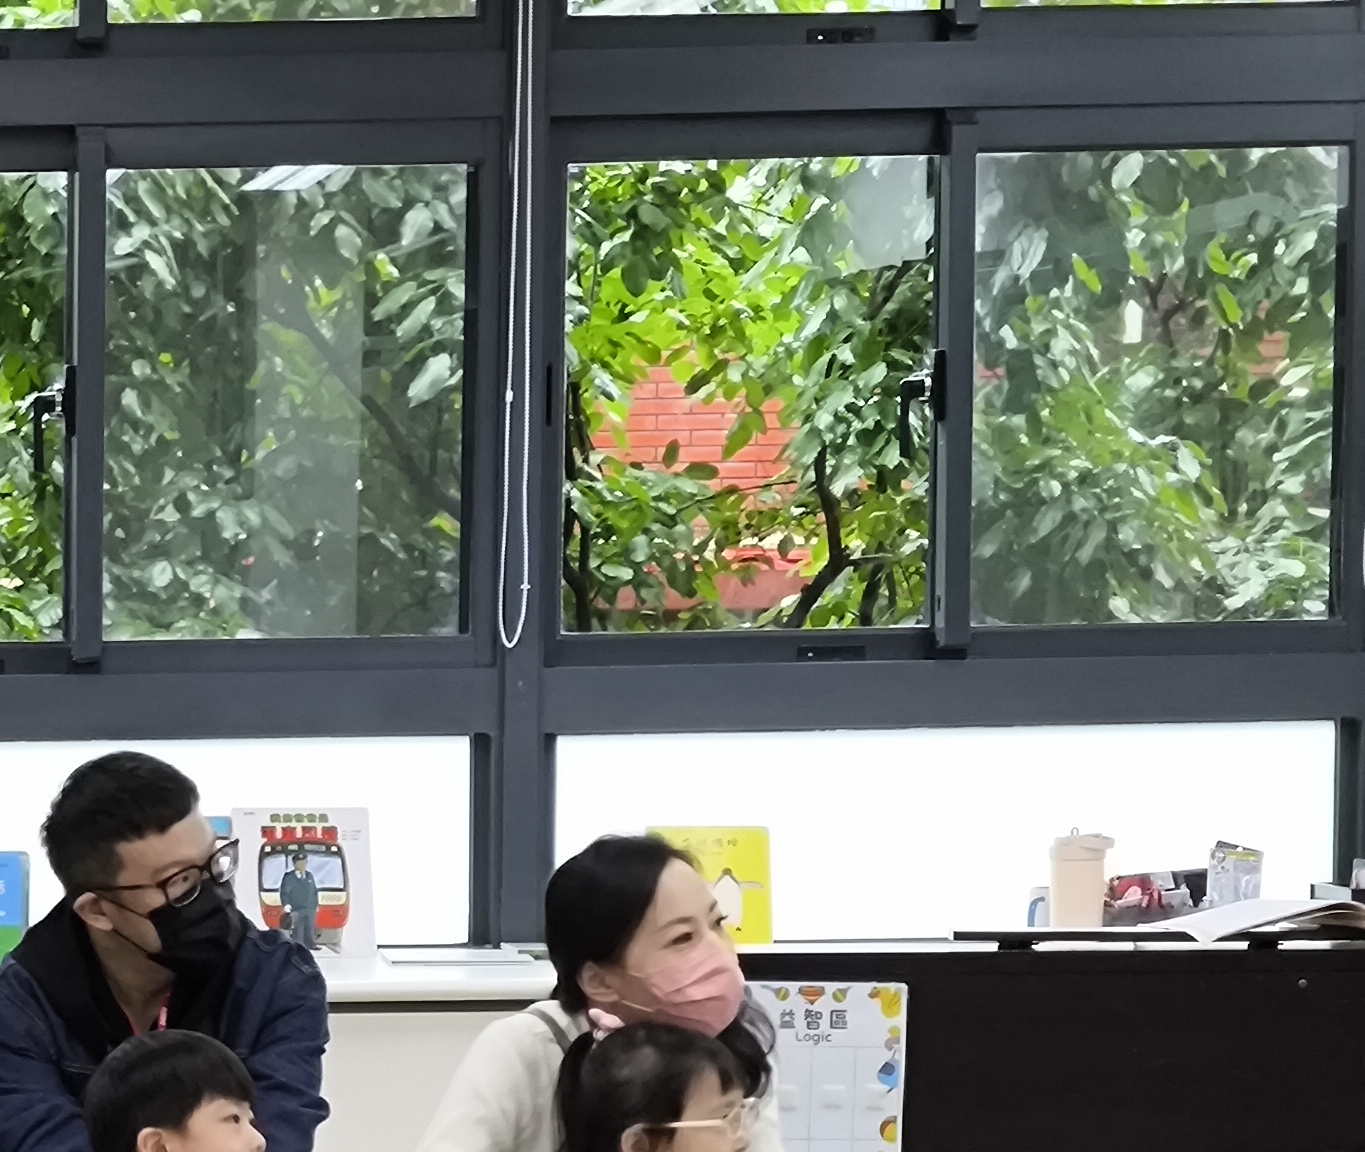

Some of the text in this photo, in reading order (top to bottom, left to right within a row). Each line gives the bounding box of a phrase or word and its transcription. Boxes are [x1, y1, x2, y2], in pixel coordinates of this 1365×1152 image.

[779, 1009, 848, 1030] 益智區
[796, 1032, 832, 1045] Logic
